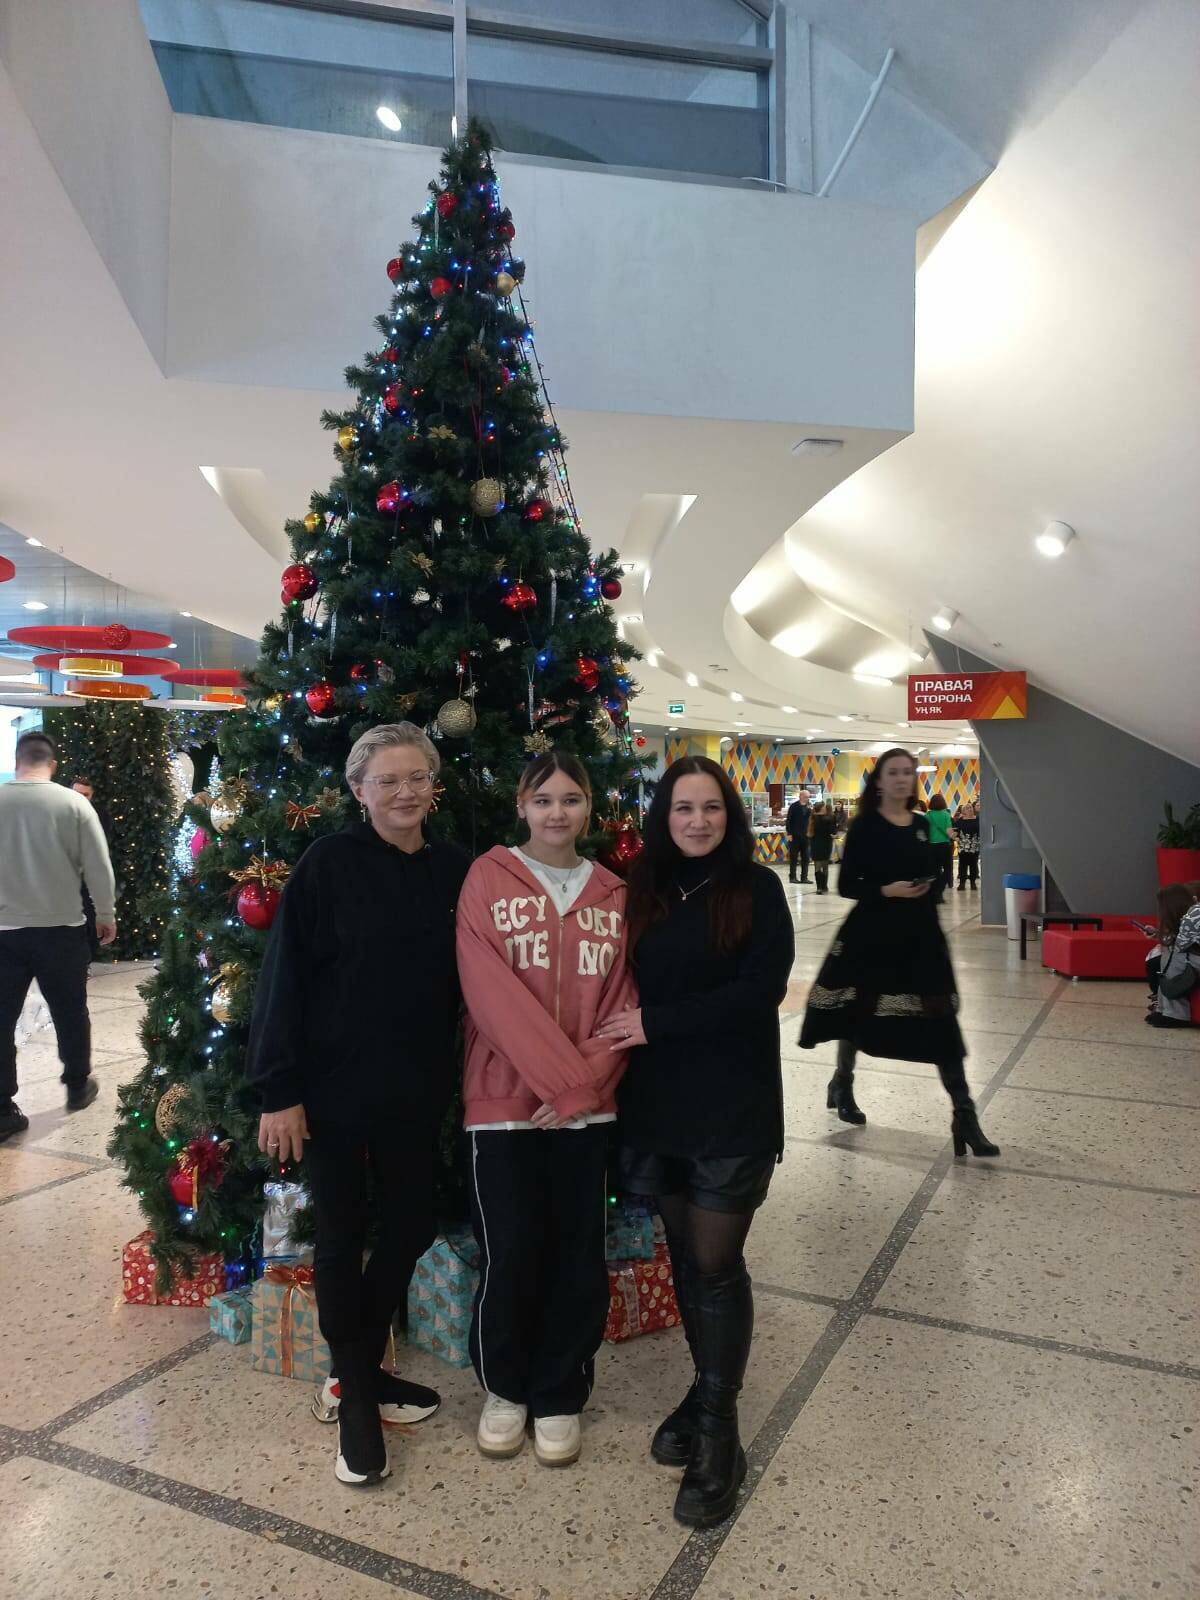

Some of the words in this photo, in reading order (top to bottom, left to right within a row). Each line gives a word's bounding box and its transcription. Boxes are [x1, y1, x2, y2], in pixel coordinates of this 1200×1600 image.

[915, 680, 973, 691] ПРАВАЯ
[915, 694, 973, 704] СТОРОНА
[929, 706, 942, 714] ЯК
[577, 940, 618, 977] NO
